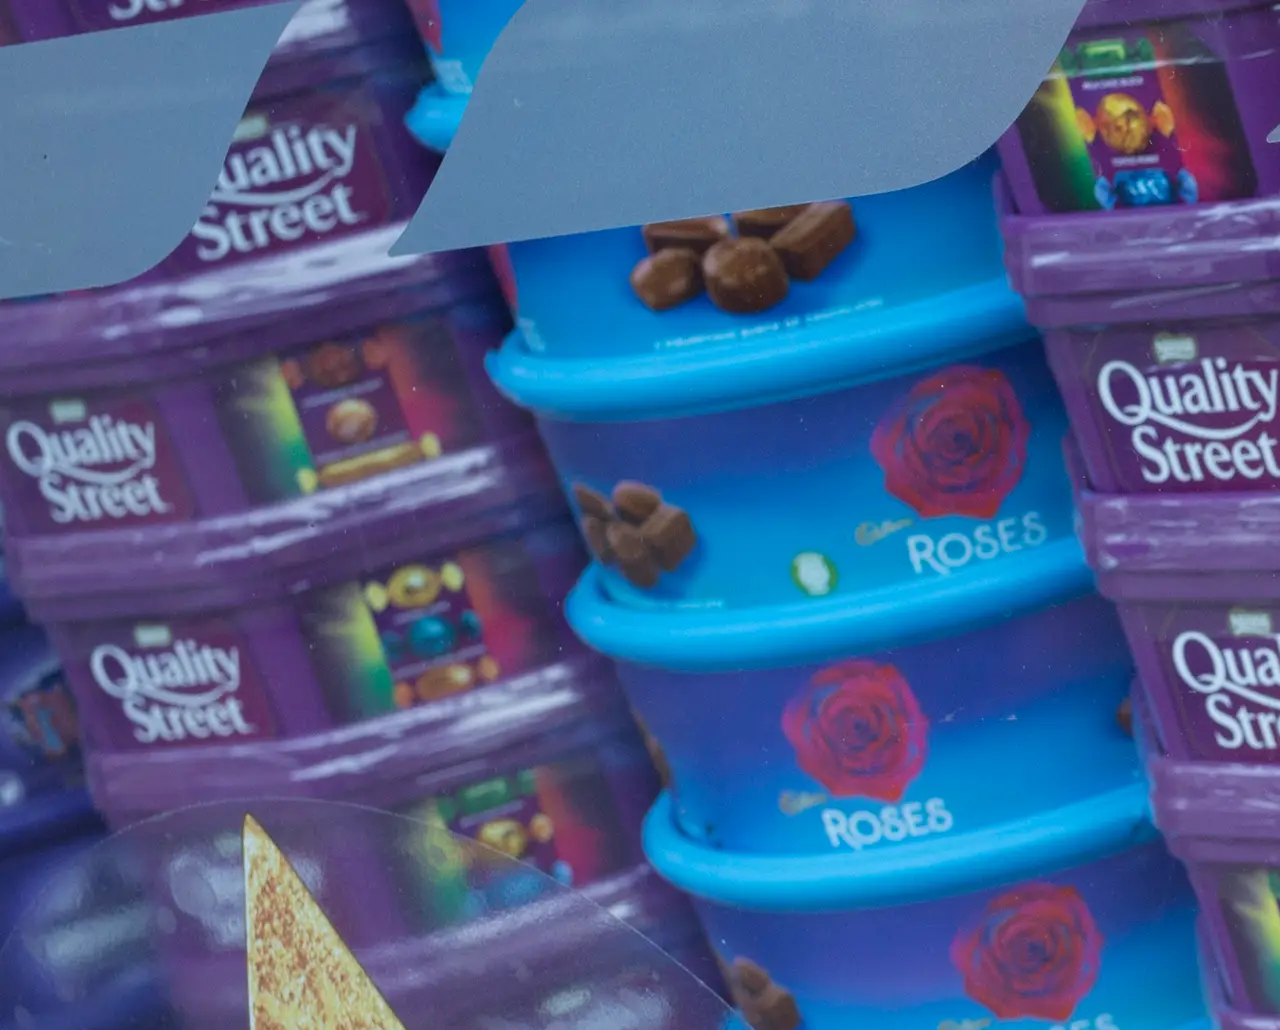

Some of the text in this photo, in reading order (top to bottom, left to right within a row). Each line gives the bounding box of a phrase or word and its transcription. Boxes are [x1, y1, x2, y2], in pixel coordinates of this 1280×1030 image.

[209, 124, 356, 204] uality
[192, 183, 362, 261] Street
[1098, 357, 1278, 439] Quality
[7, 419, 156, 484] Quality
[40, 469, 165, 525] Street
[907, 511, 1048, 575] ROSES
[92, 641, 241, 704] Quality
[125, 696, 253, 743] Street
[822, 798, 953, 851] ROSES
